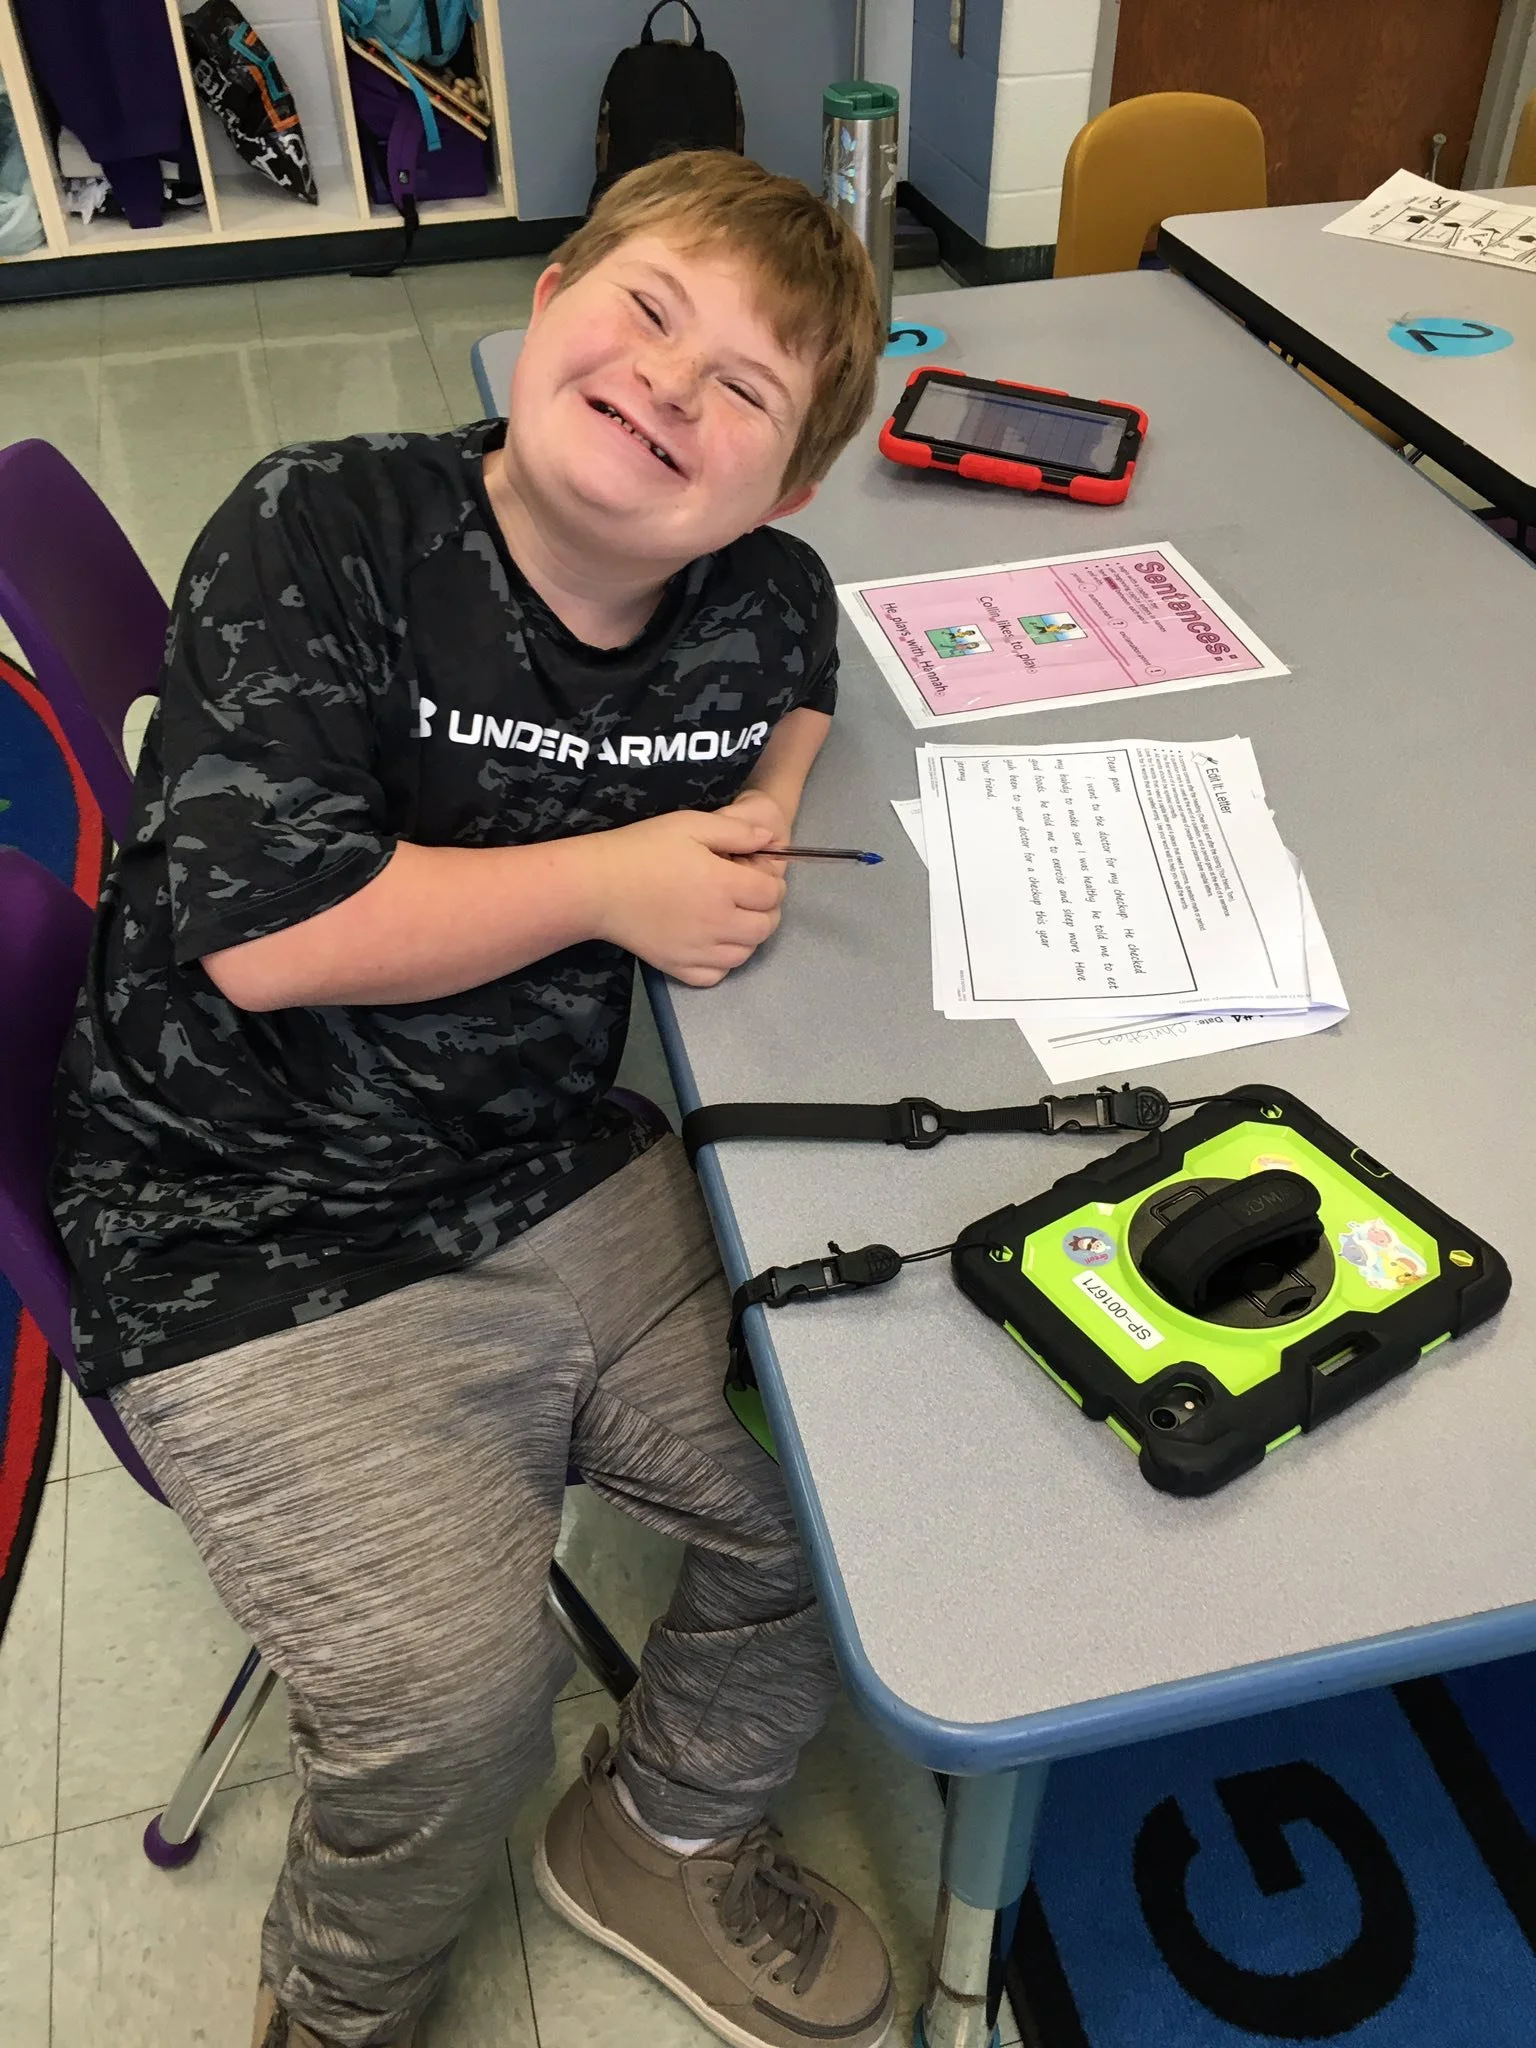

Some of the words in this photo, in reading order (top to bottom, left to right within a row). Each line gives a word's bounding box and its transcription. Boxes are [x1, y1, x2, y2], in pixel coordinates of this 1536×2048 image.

[1405, 322, 1494, 353] 2
[883, 602, 898, 614] He
[1135, 561, 1238, 661] Sentences:
[889, 616, 911, 637] plays
[979, 595, 1000, 618] Collin
[995, 619, 1014, 638] likes
[1010, 640, 1023, 650] to
[906, 638, 926, 657] with
[449, 709, 590, 770] UNDER
[597, 721, 768, 766] ARMOUR
[953, 759, 966, 782] jeremy
[980, 759, 990, 774] Your
[1002, 758, 1017, 771] yuh
[1027, 757, 1042, 771] gud
[1053, 758, 1064, 770] my
[1105, 755, 1117, 773] Dear
[983, 777, 997, 799] friend,
[1008, 774, 1019, 790] been
[1058, 773, 1072, 794] bahdy
[1107, 776, 1121, 793] pam
[1205, 767, 1221, 783] Edit
[1214, 791, 1232, 814] Letter
[1012, 793, 1021, 802] to
[1086, 782, 1098, 800] went
[1039, 799, 1050, 809] he
[1064, 797, 1073, 805] to
[1091, 803, 1100, 811] tu
[1011, 805, 1025, 822] your
[1041, 812, 1055, 827] told
[1067, 808, 1079, 827] make
[1094, 815, 1105, 827] the
[1018, 825, 1030, 849] doctor
[1046, 830, 1055, 842] me
[1071, 831, 1083, 846] sure
[1098, 830, 1111, 853] doctor
[1023, 851, 1035, 863] for
[1048, 845, 1058, 854] to
[1078, 857, 1089, 872] was
[1105, 856, 1117, 868] for
[1051, 857, 1065, 885] exercise
[1107, 871, 1119, 885] my
[1028, 876, 1042, 906] checkup
[1058, 889, 1072, 904] and
[1083, 875, 1098, 903] healthy
[1113, 888, 1128, 920] checkup.
[1034, 910, 1048, 925] this
[1061, 908, 1074, 927] sleep
[1090, 909, 1102, 919] he
[1034, 929, 1050, 948] year
[1093, 924, 1108, 940] told
[1123, 927, 1135, 939] He
[1068, 932, 1080, 953] more
[1099, 944, 1110, 958] me
[1103, 962, 1113, 972] to
[1127, 943, 1146, 974] checked
[1074, 961, 1086, 981] Have
[1106, 976, 1119, 989] eet
[1194, 1015, 1224, 1026] Date:
[1097, 1023, 1188, 1046] Christian
[1081, 1278, 1151, 1341] SP-001671
[1132, 1759, 1418, 2041] G
